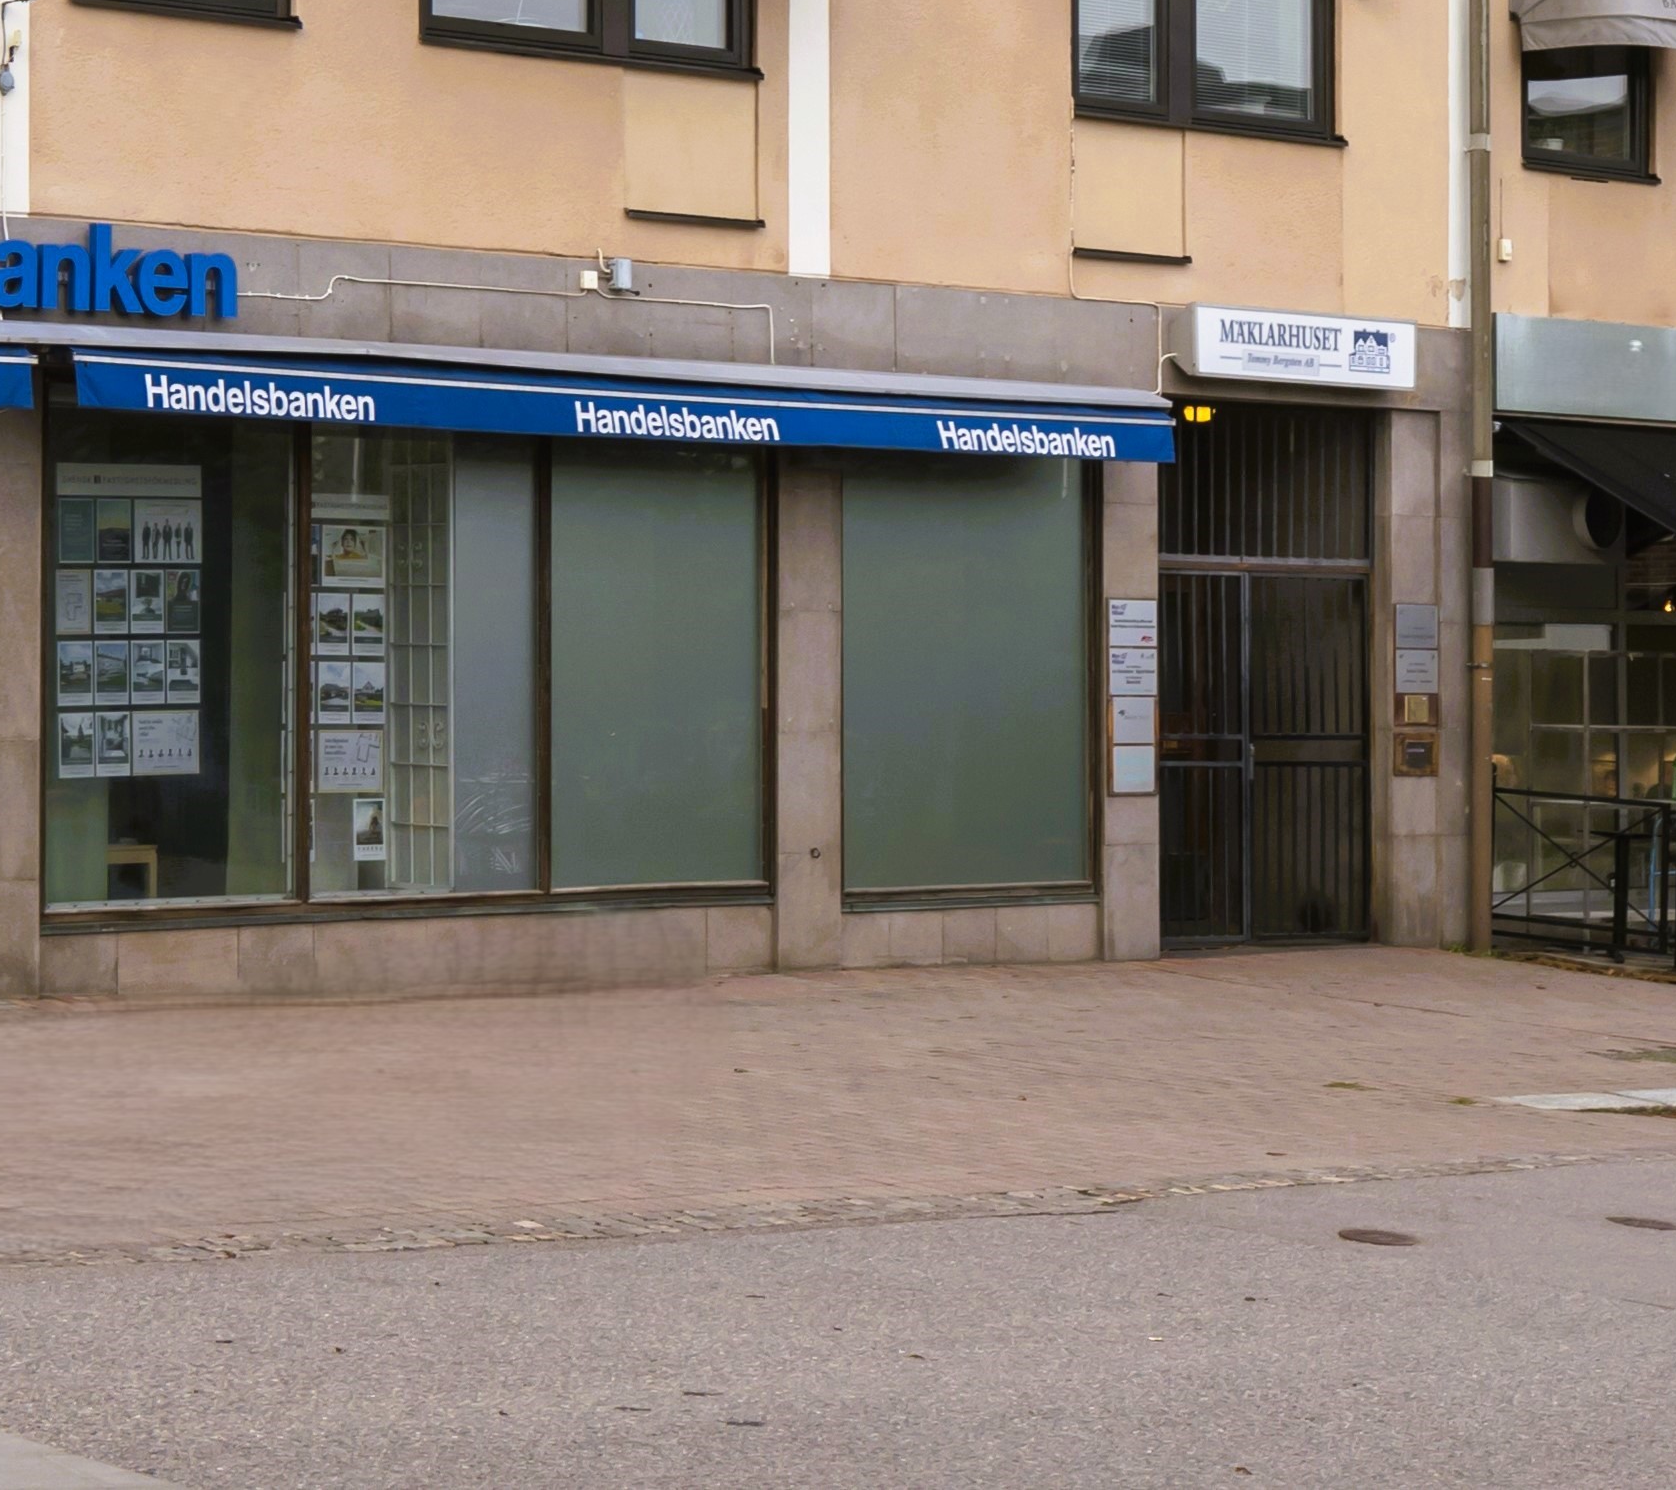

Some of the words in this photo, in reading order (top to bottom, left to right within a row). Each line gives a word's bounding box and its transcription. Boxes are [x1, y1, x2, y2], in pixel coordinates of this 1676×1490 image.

[1219, 318, 1342, 352] MÄKLARHUSET
[144, 373, 376, 421] Handelsbanken
[574, 400, 780, 442] Handelsbanken
[936, 420, 1117, 459] Handelsbanken
